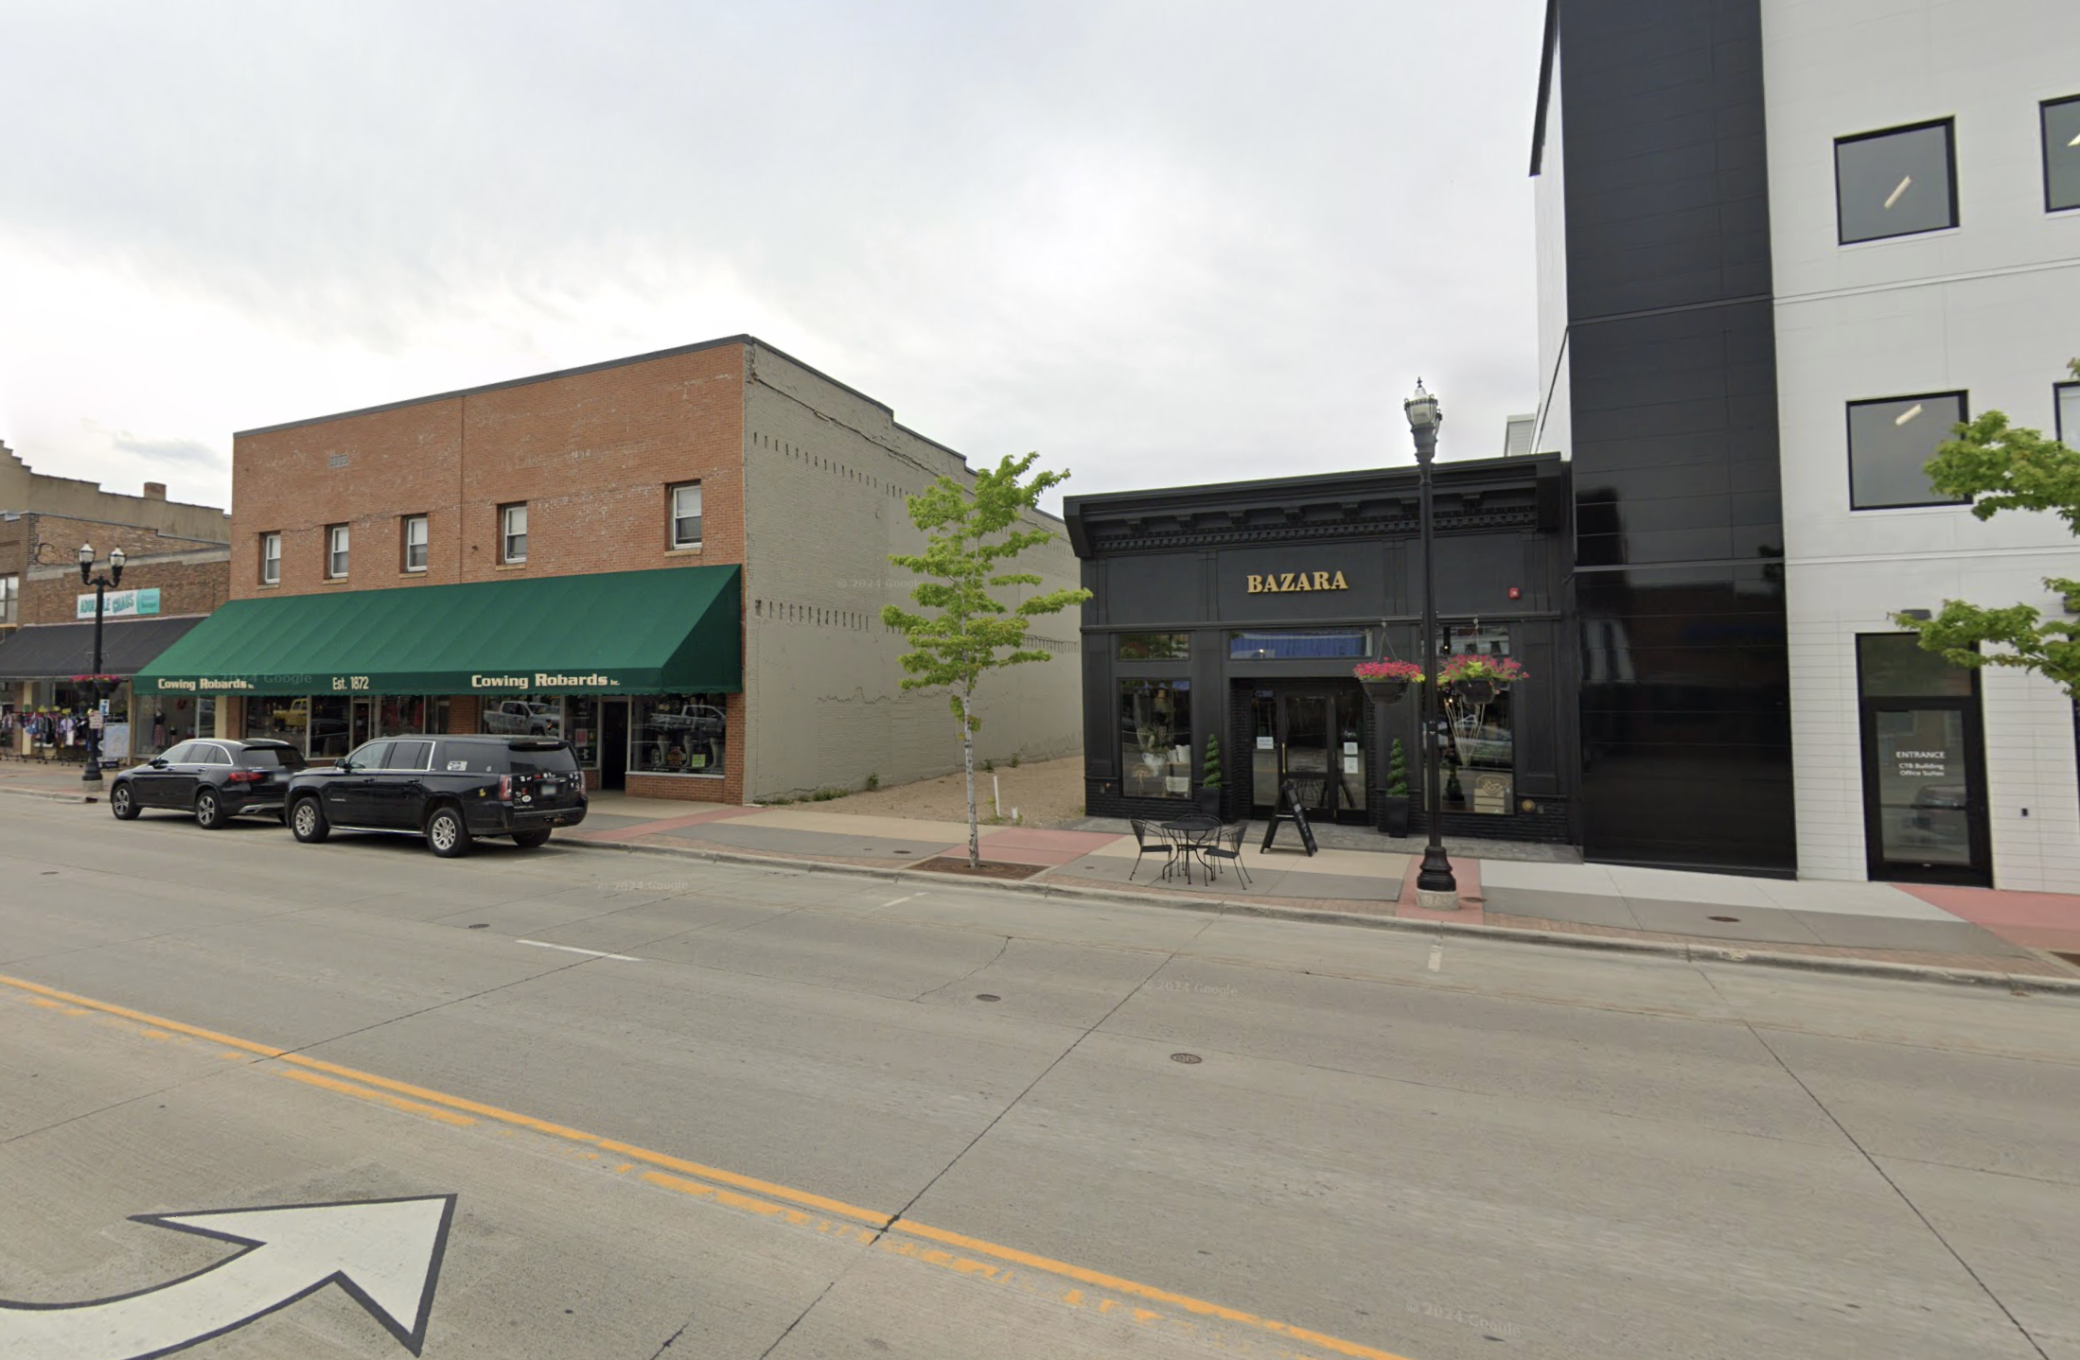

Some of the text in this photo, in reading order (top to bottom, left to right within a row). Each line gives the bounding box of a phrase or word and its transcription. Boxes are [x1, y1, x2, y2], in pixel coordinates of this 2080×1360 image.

[1247, 570, 1349, 593] BAZARA
[158, 678, 196, 691] Cowing
[200, 677, 247, 690] Robards
[332, 676, 369, 690] Est. 1872
[471, 674, 529, 689] Cowing
[535, 673, 608, 687] Robards
[1895, 750, 1945, 759] ENTRANCE
[1915, 762, 1945, 770] Building
